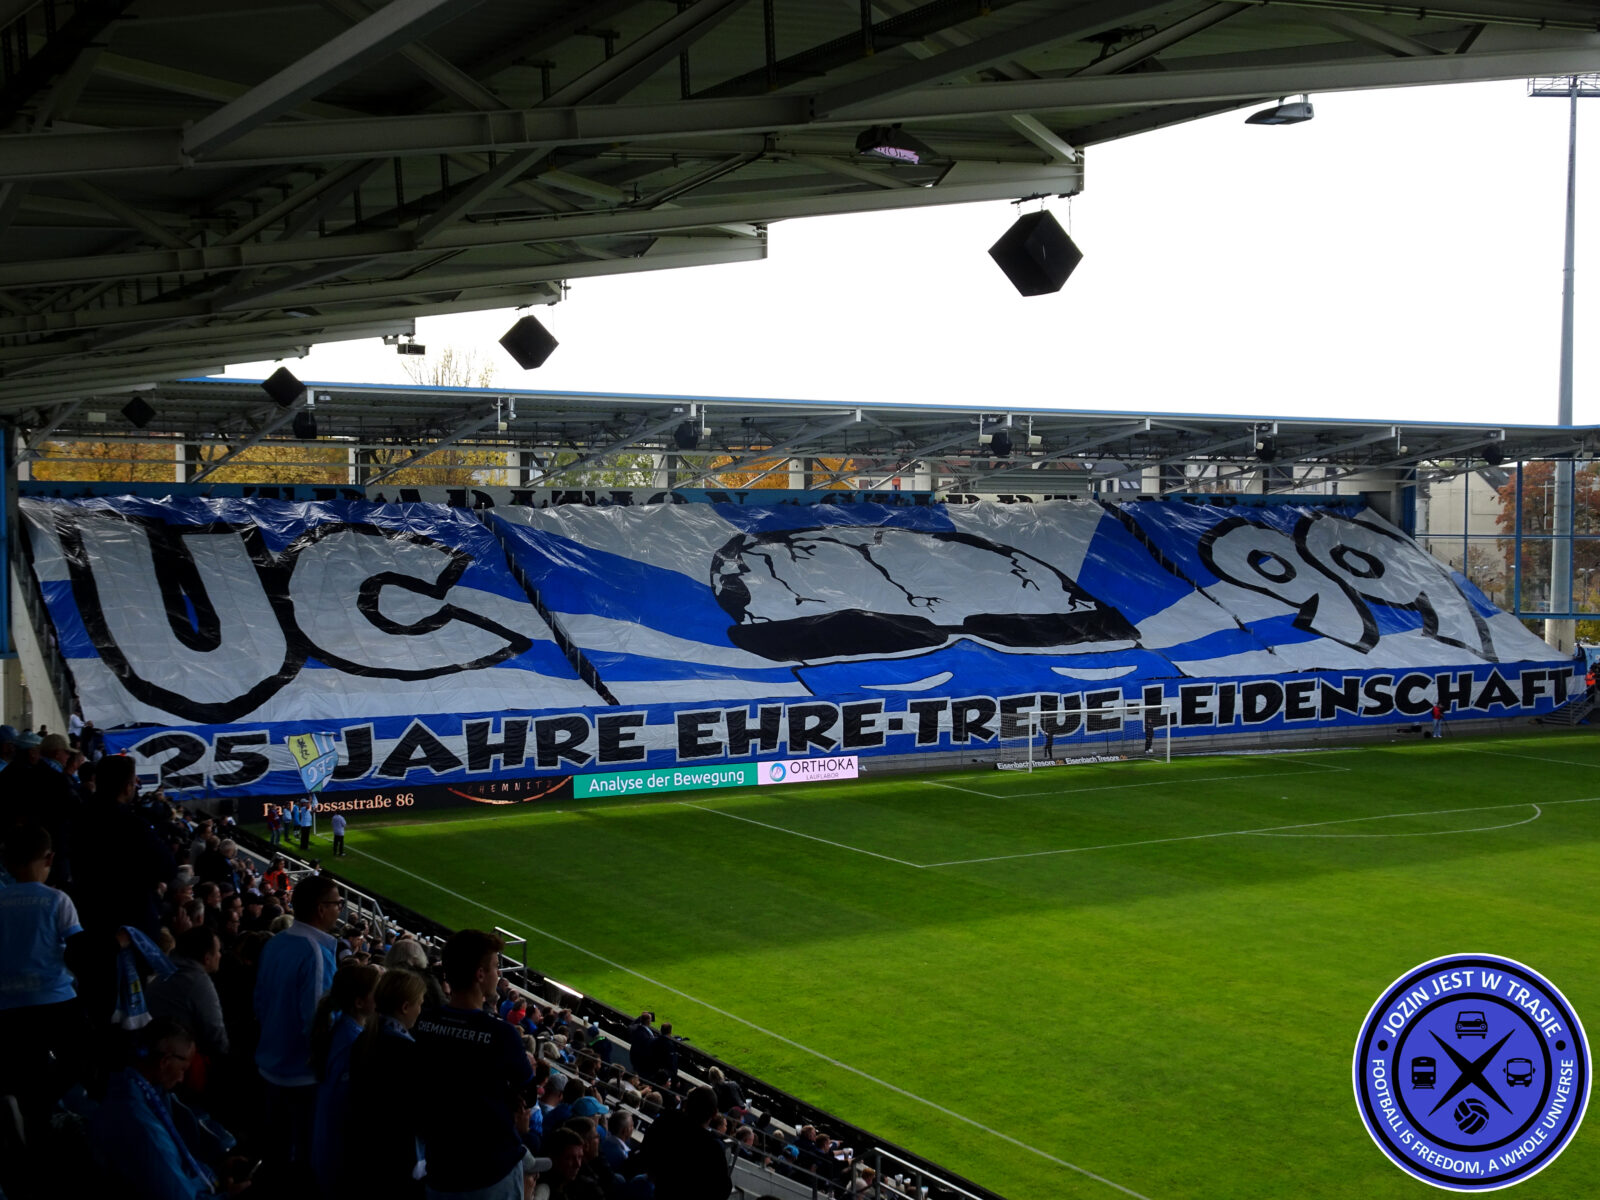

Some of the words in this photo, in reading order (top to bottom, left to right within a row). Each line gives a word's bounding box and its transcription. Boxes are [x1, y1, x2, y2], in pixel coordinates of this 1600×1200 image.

[134, 729, 271, 791] 25
[329, 709, 648, 782] JAHRE
[790, 759, 854, 774] ORTHOKA
[589, 774, 643, 793] Analyse
[647, 772, 670, 788] der
[674, 769, 745, 788] Bewegung
[396, 793, 414, 807] 86
[477, 1031, 492, 1044] FC
